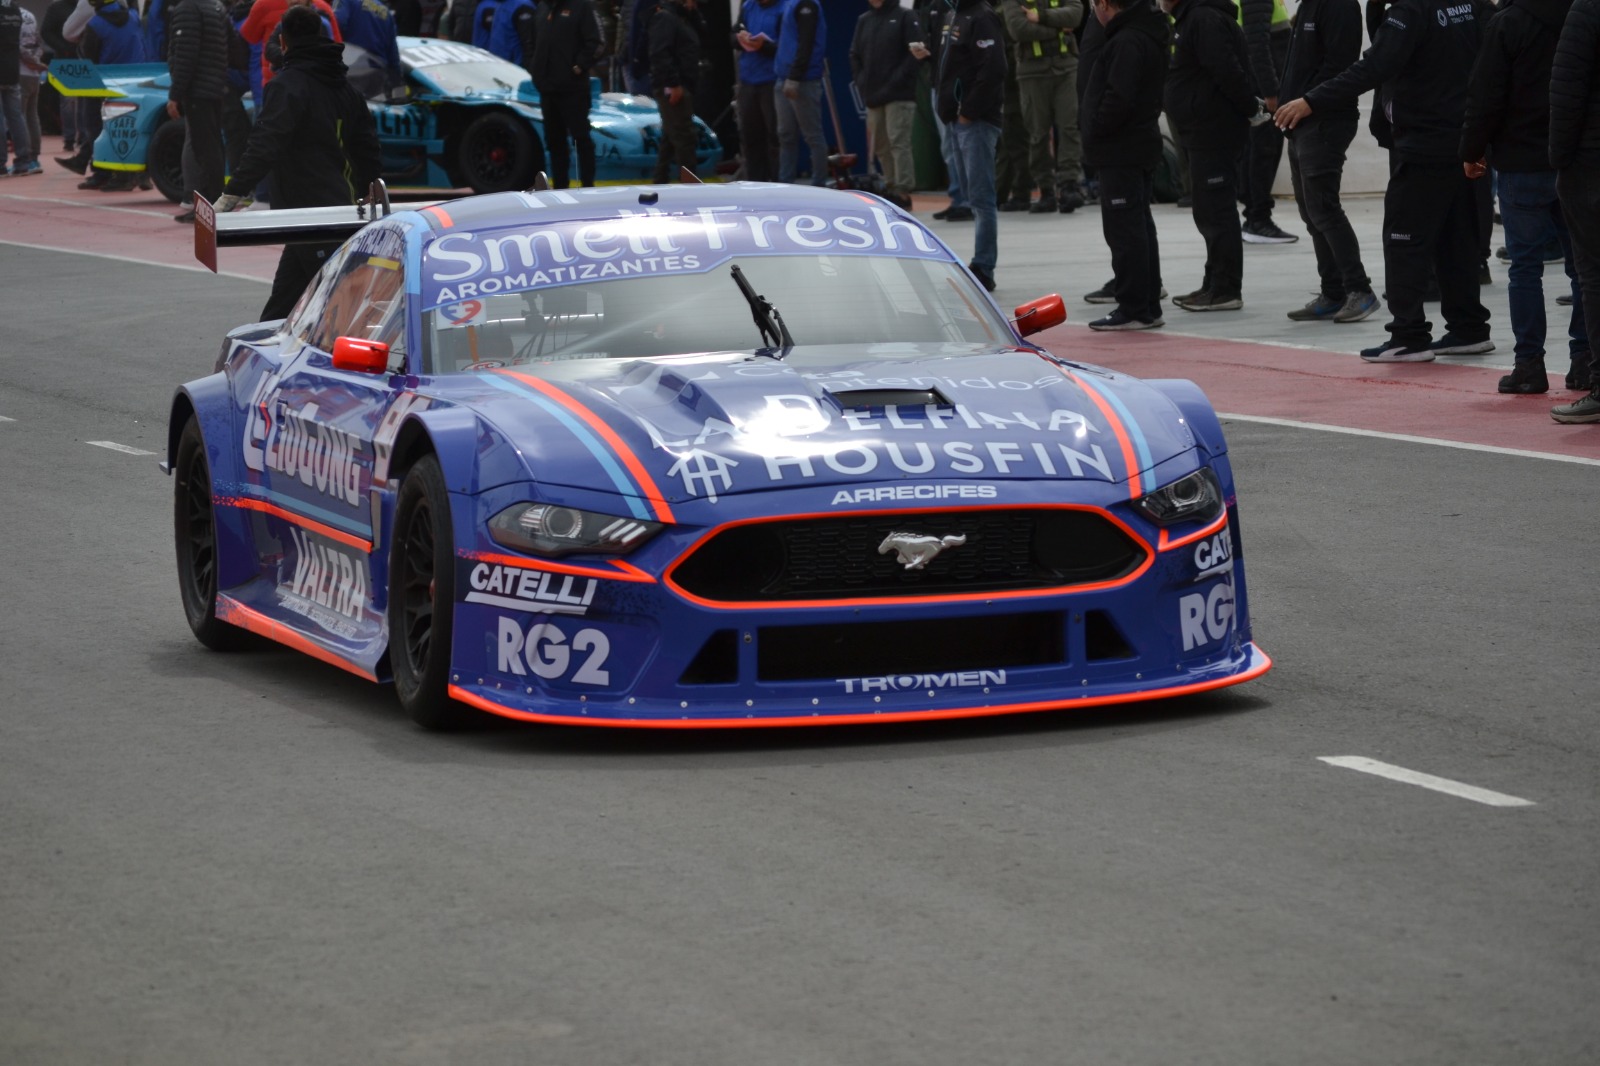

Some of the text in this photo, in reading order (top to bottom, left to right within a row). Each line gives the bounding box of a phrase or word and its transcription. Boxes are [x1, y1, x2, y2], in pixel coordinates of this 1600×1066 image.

[59, 64, 90, 76] AQUA
[111, 130, 138, 139] KING
[113, 119, 136, 129] SAFE
[427, 206, 686, 282] Smell
[697, 204, 938, 254] Fresh
[436, 255, 701, 304] AROMATIZANTES
[755, 440, 1117, 484] HOUSFIN
[830, 484, 999, 506] ARRECIFES
[289, 526, 365, 622] VALTRA
[469, 562, 598, 606] CATELLI
[497, 615, 611, 687] RG2
[835, 669, 1007, 694] TROMEN
